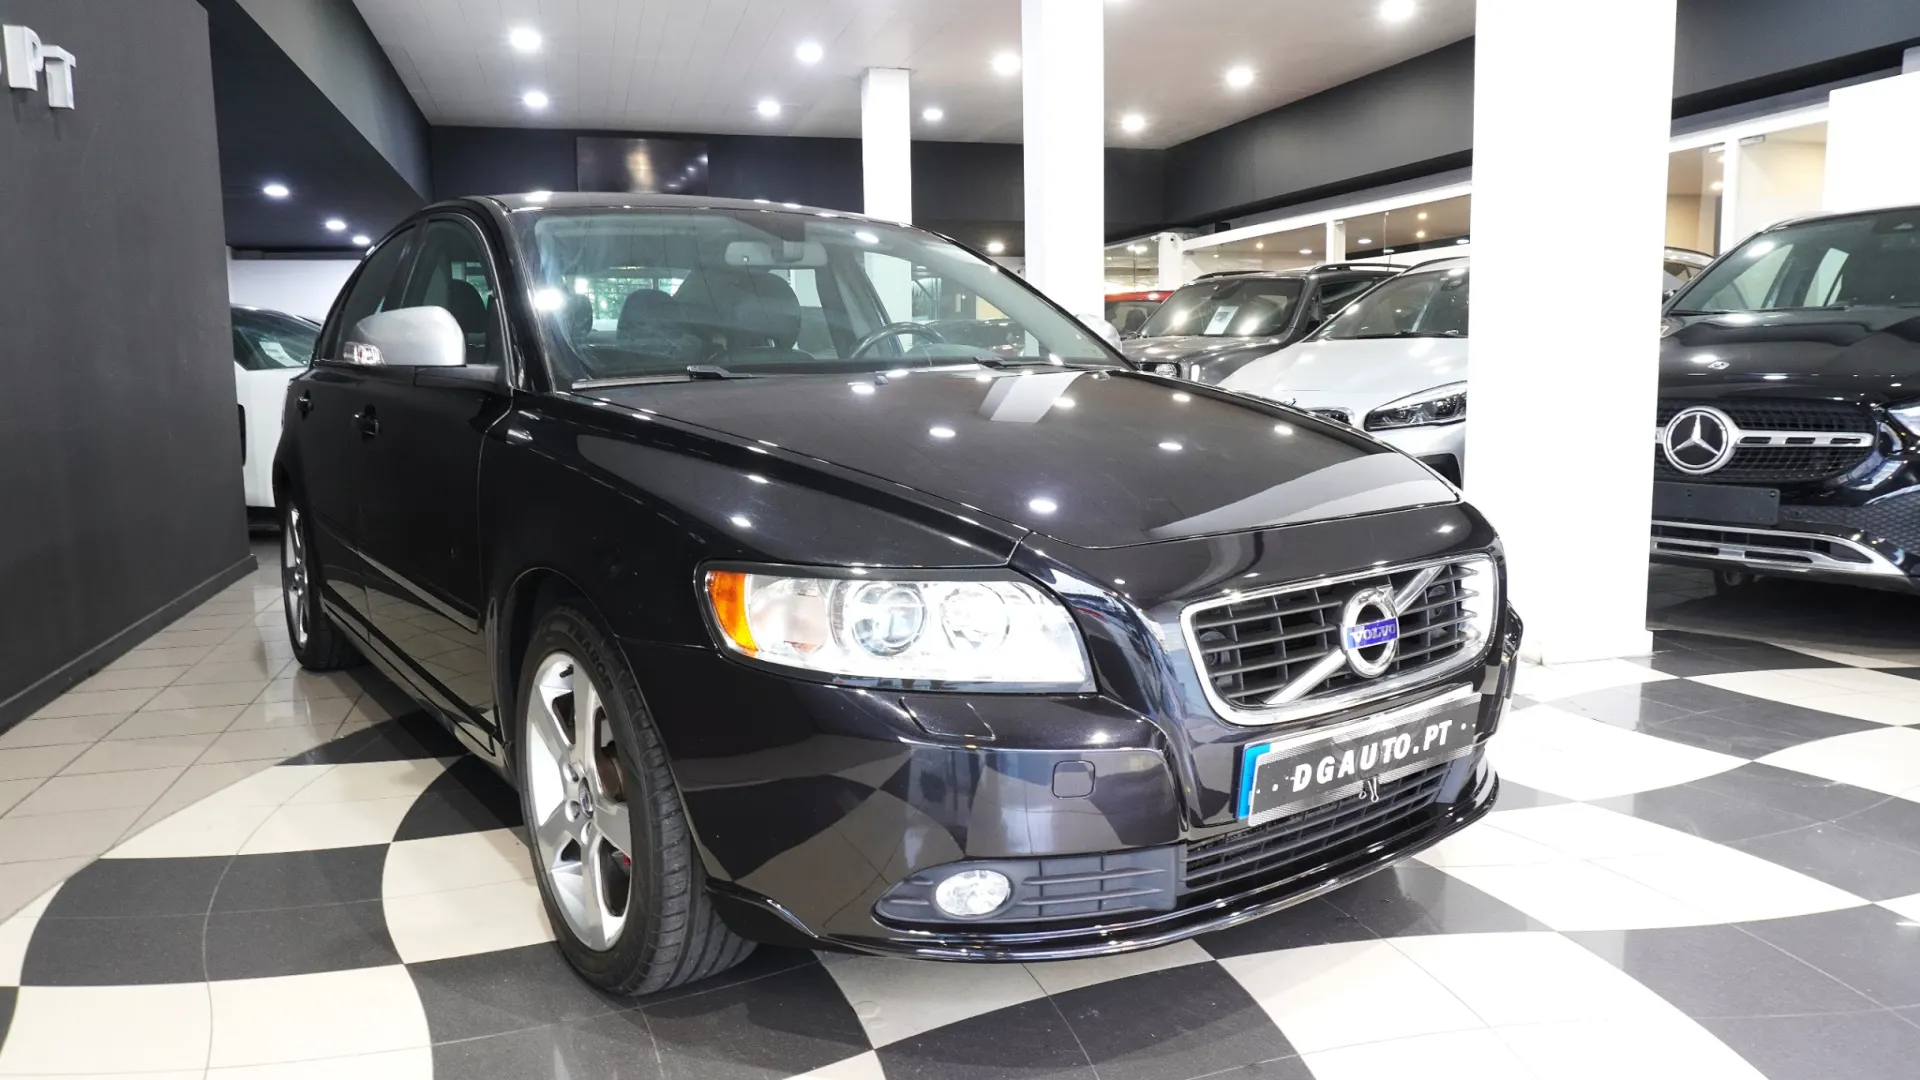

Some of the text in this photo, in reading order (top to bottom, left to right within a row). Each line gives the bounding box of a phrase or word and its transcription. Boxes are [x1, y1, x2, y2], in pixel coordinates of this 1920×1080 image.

[0, 24, 76, 110] PT
[1350, 624, 1396, 643] VOLVO
[1292, 720, 1453, 793] DGAUTO.PT
